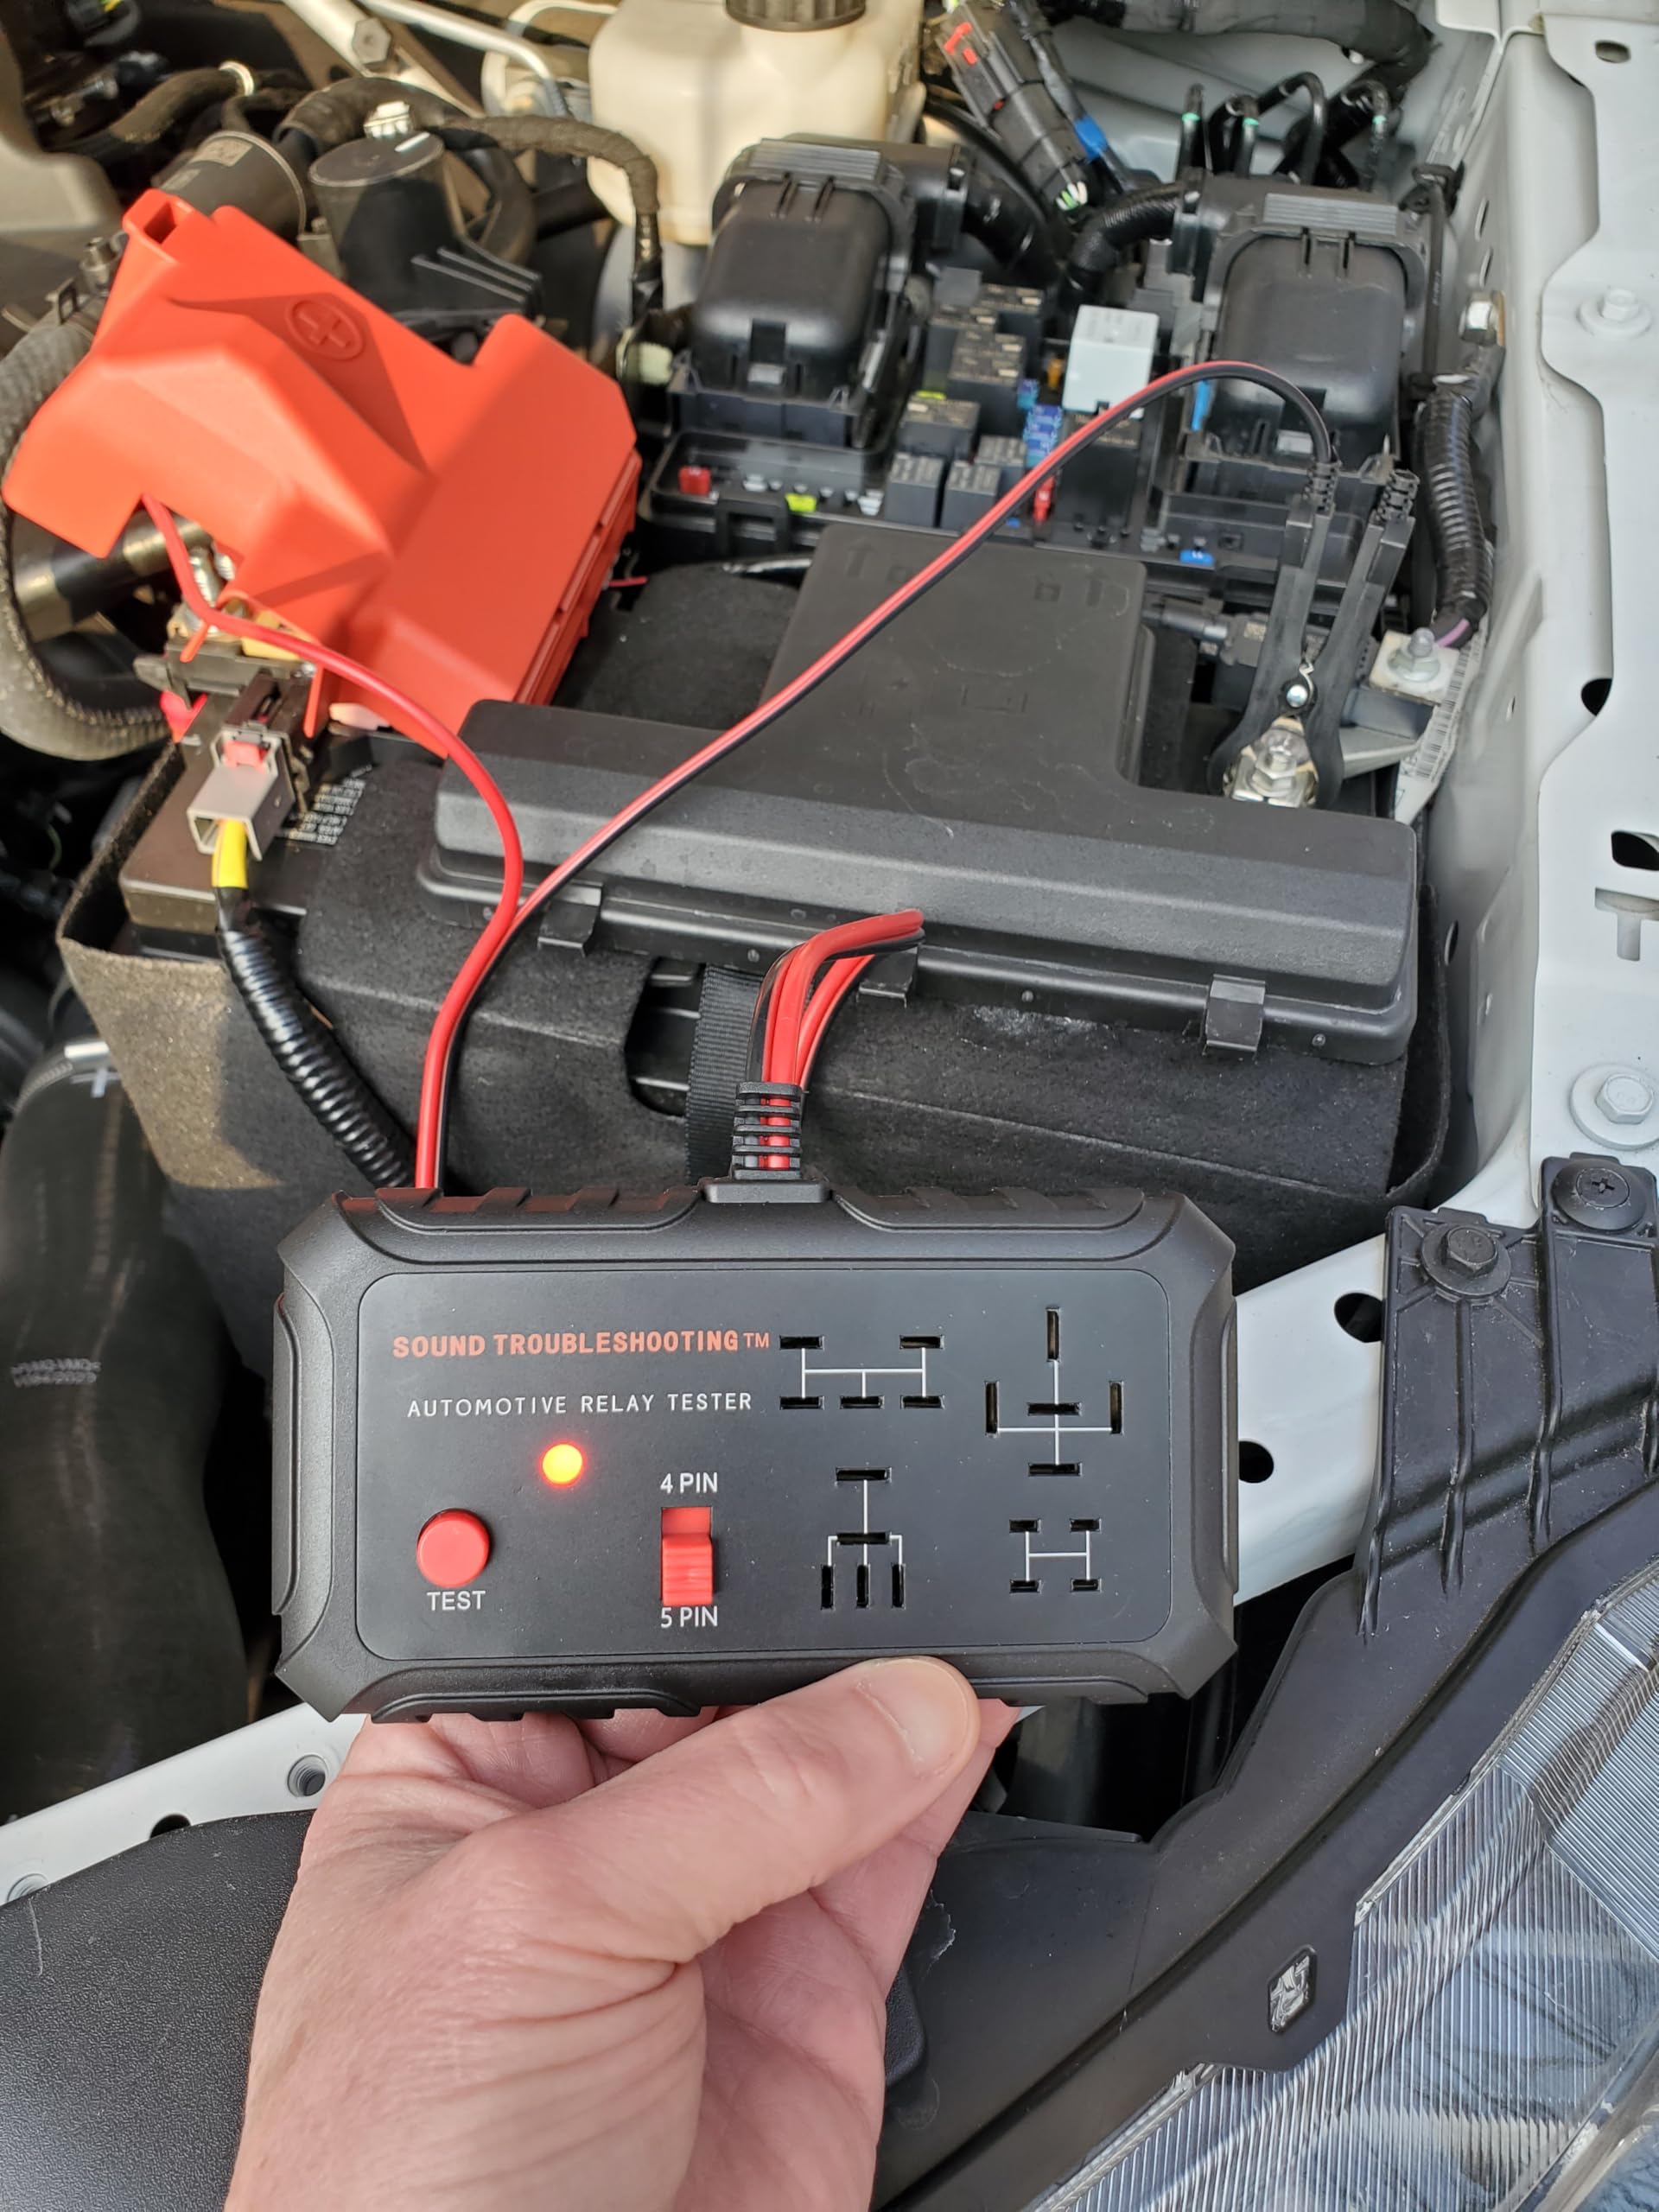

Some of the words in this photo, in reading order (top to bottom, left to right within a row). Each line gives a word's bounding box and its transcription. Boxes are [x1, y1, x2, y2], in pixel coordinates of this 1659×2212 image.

[393, 1335, 485, 1357] SOUND
[407, 1396, 567, 1418] AUTOMOTIVE
[581, 1394, 654, 1414] RELAY
[667, 1392, 753, 1412] TESTER
[660, 1472, 673, 1494] 4
[680, 1471, 718, 1493] PIN
[427, 1590, 486, 1611] TEST
[660, 1606, 672, 1629] 5
[680, 1605, 718, 1628] PIN
